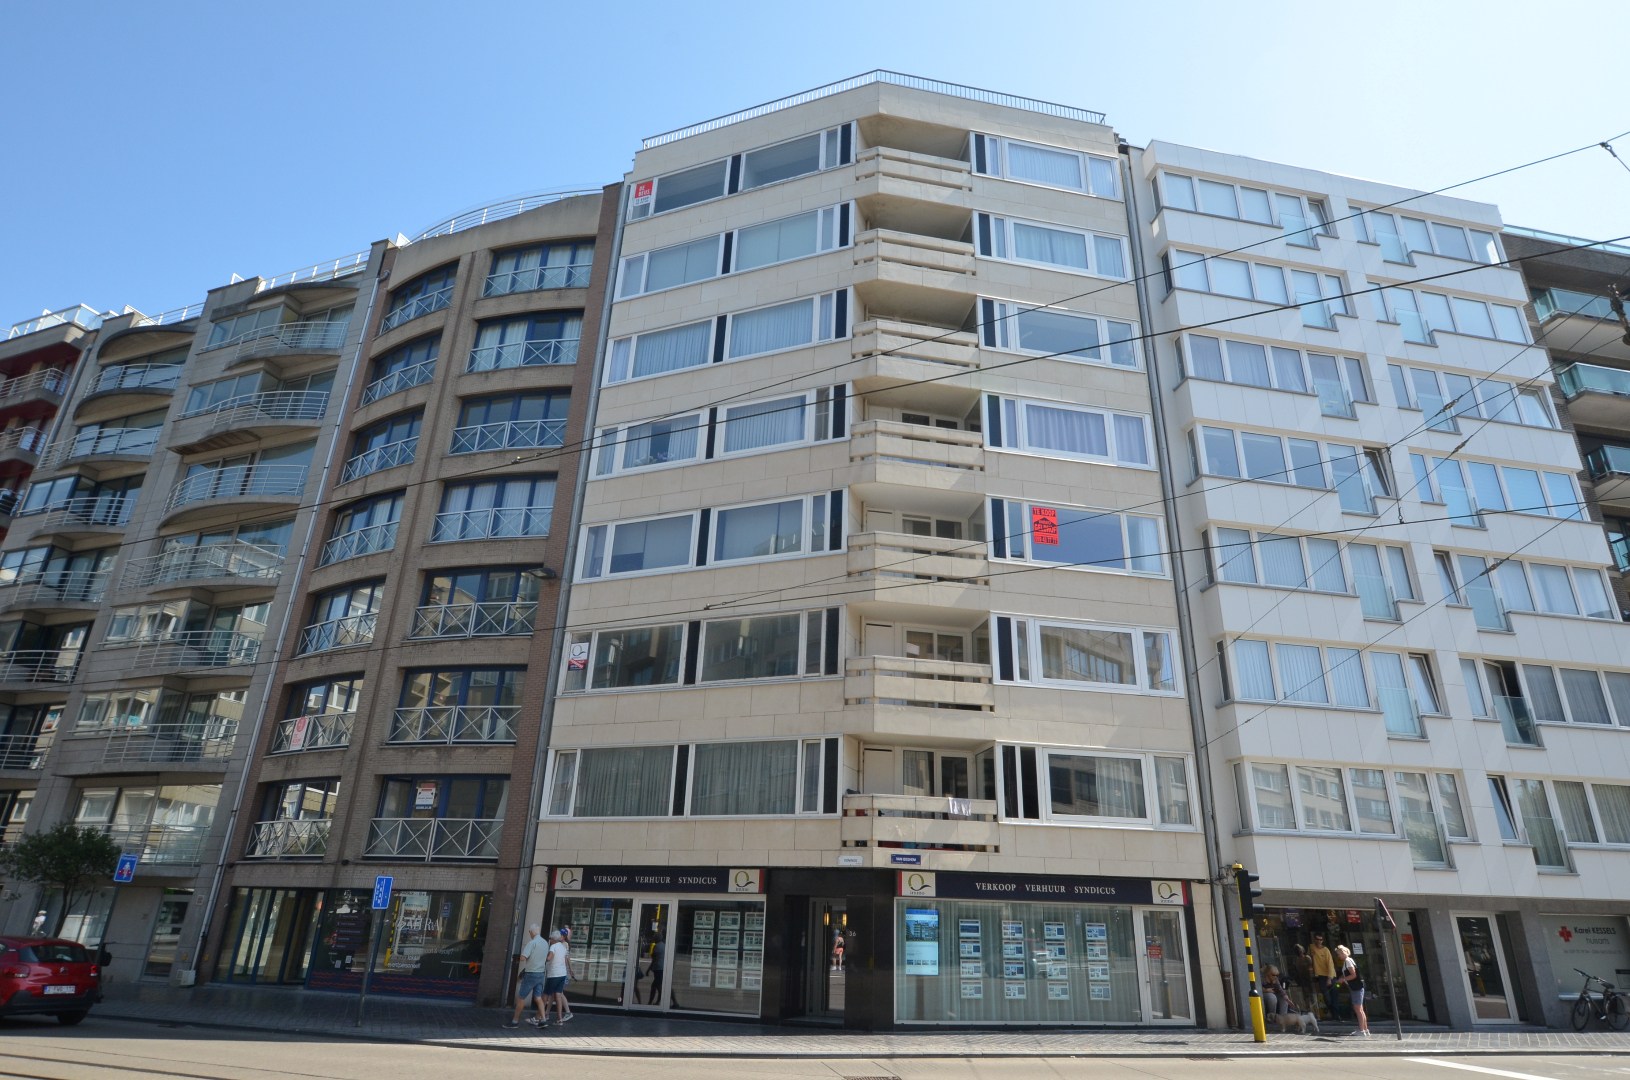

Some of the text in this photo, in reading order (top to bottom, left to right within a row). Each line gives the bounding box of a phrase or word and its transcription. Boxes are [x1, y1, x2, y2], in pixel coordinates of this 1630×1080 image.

[1033, 507, 1056, 517] TE KOOP
[593, 875, 717, 885] VERKOOP VERHUUR SYNDICUS
[975, 882, 1116, 895] VERKOOP VERHUUR SYNDICUS
[1573, 926, 1617, 935] Karel KESSELS
